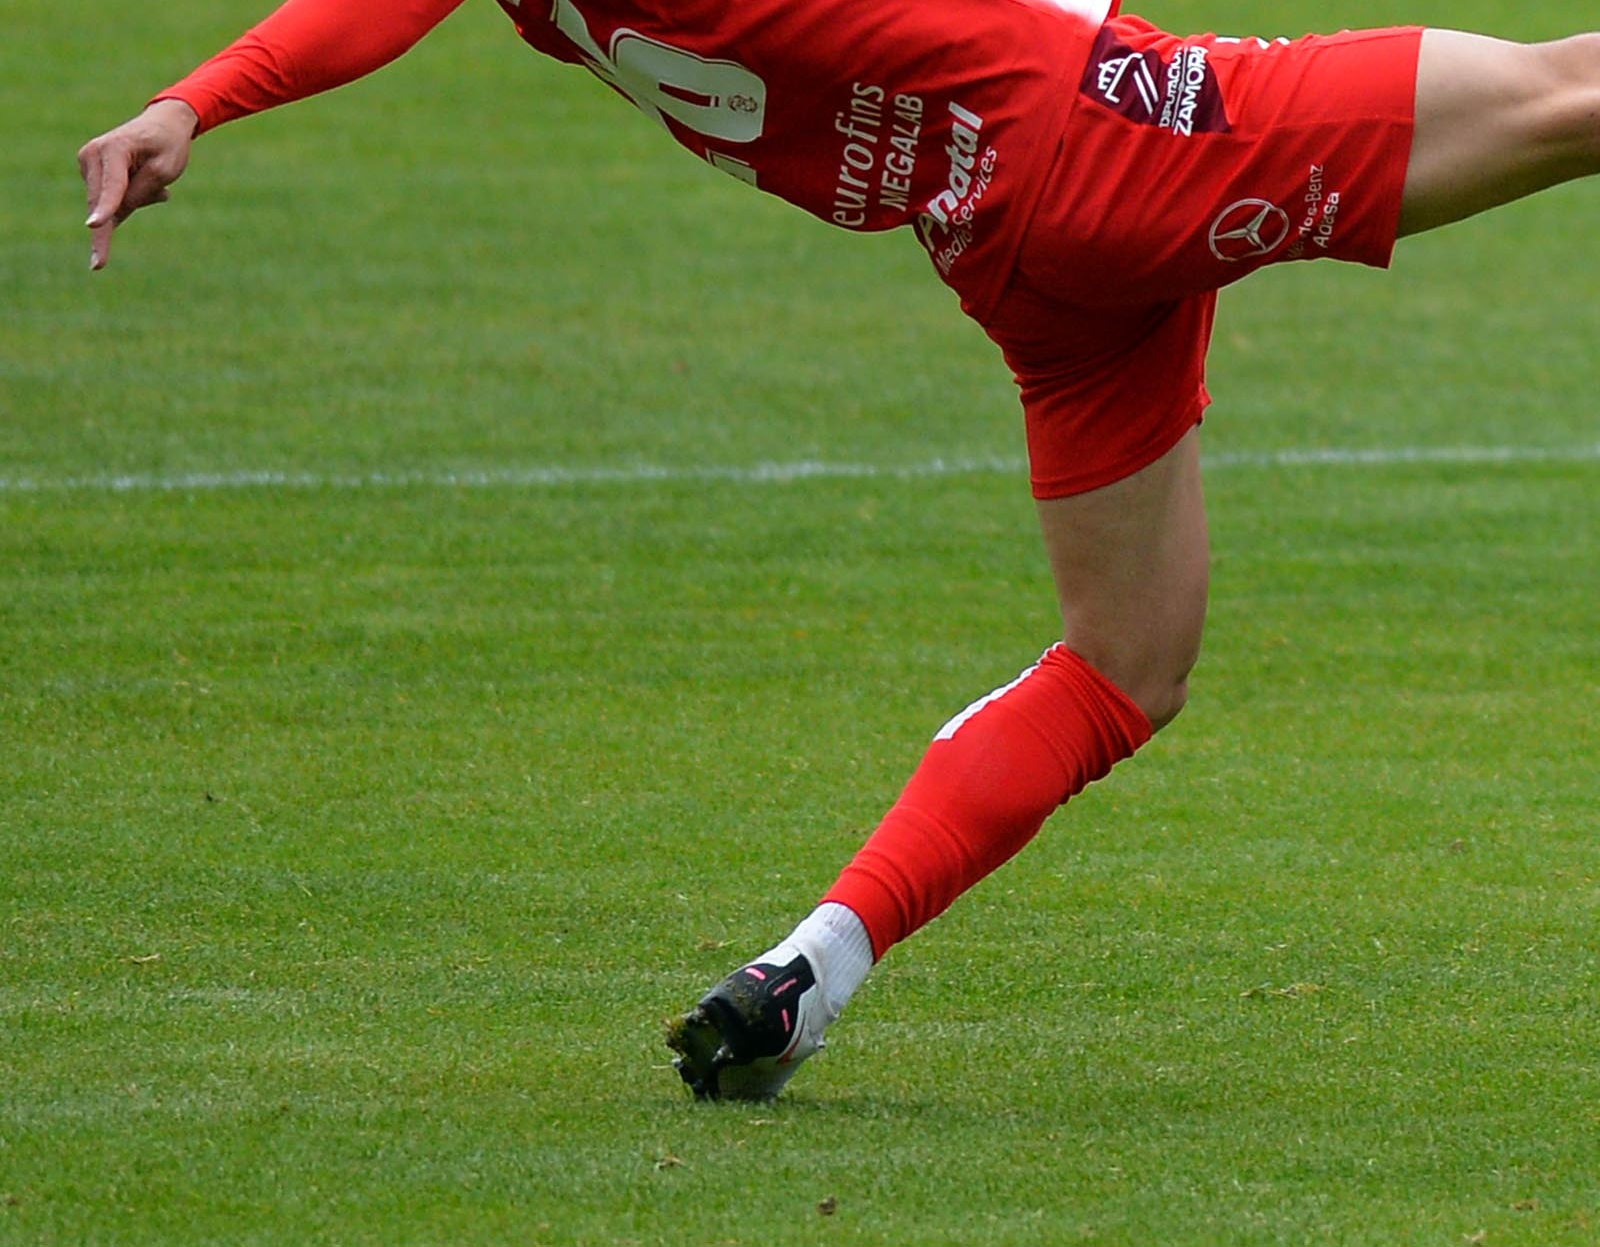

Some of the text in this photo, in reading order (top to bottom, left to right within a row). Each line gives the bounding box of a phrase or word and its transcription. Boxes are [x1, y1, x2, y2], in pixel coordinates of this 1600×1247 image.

[1173, 46, 1208, 137] ZAMORA
[832, 82, 885, 227] eurofins
[879, 93, 924, 213] MEGALAB
[952, 144, 998, 230] Services
